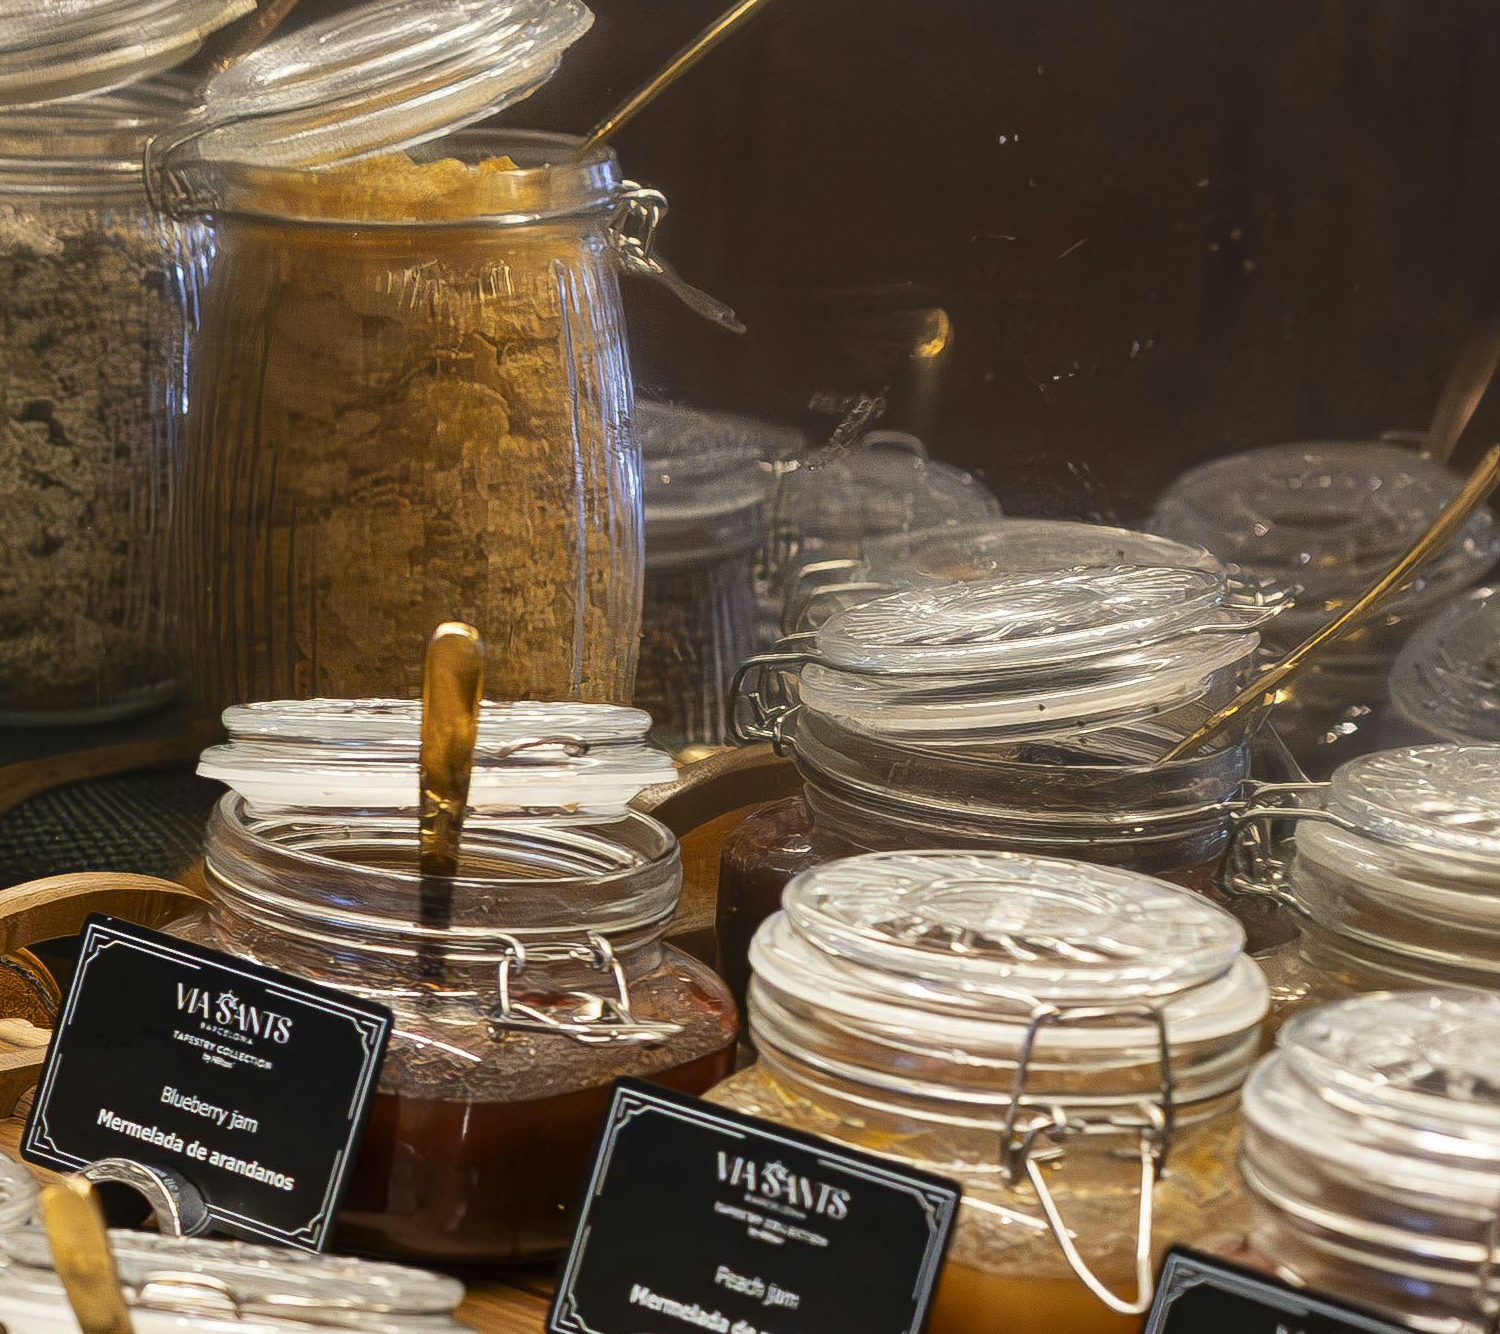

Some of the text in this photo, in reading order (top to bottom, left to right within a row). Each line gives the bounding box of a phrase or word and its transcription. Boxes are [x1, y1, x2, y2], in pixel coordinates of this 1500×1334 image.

[177, 982, 293, 1044] VIA SANTS
[160, 1085, 259, 1133] Blueberry jam
[96, 1108, 295, 1191] Mermelada de arandanos
